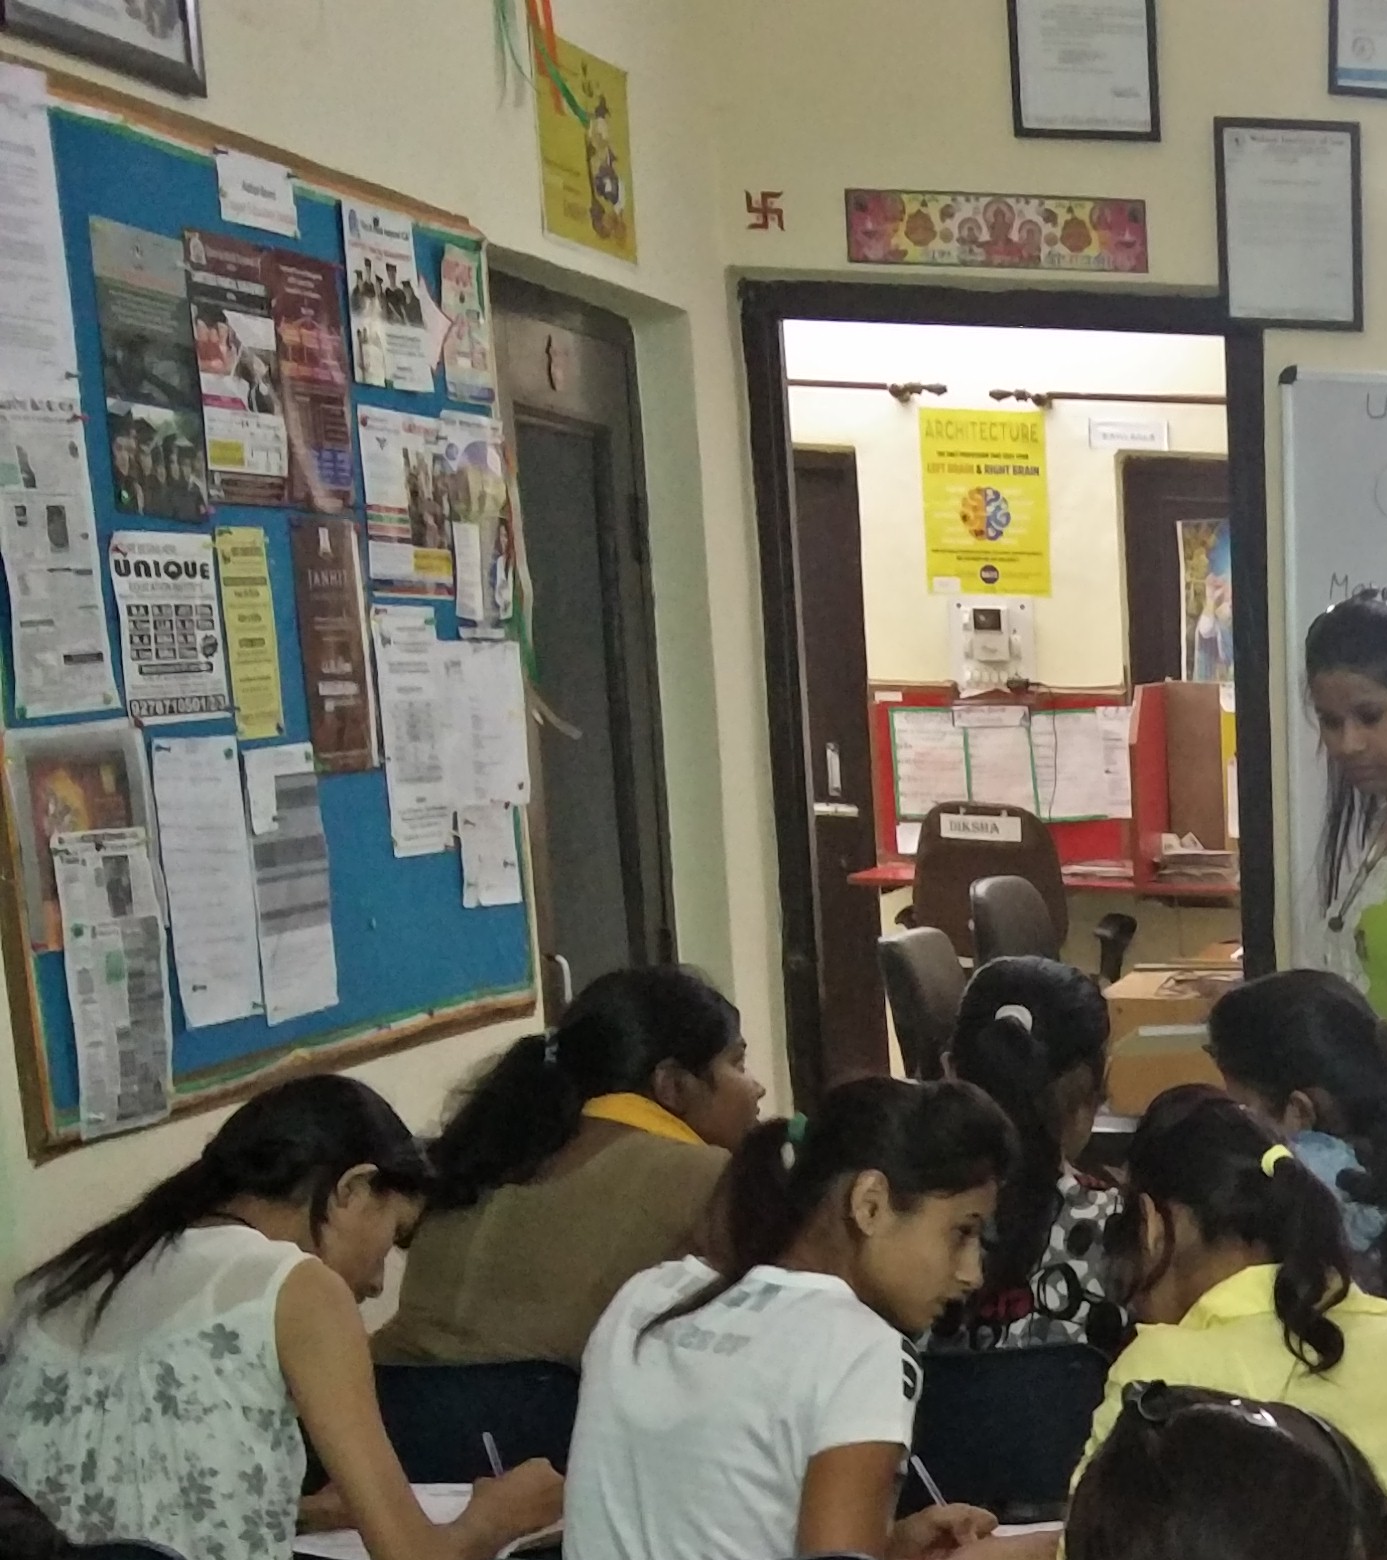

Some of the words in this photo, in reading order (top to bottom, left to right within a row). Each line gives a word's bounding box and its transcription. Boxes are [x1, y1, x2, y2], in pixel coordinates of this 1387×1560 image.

[924, 419, 1040, 444] ARCHITECTURE
[114, 559, 211, 581] UNIQUE
[949, 820, 1000, 835] DIKSHA
